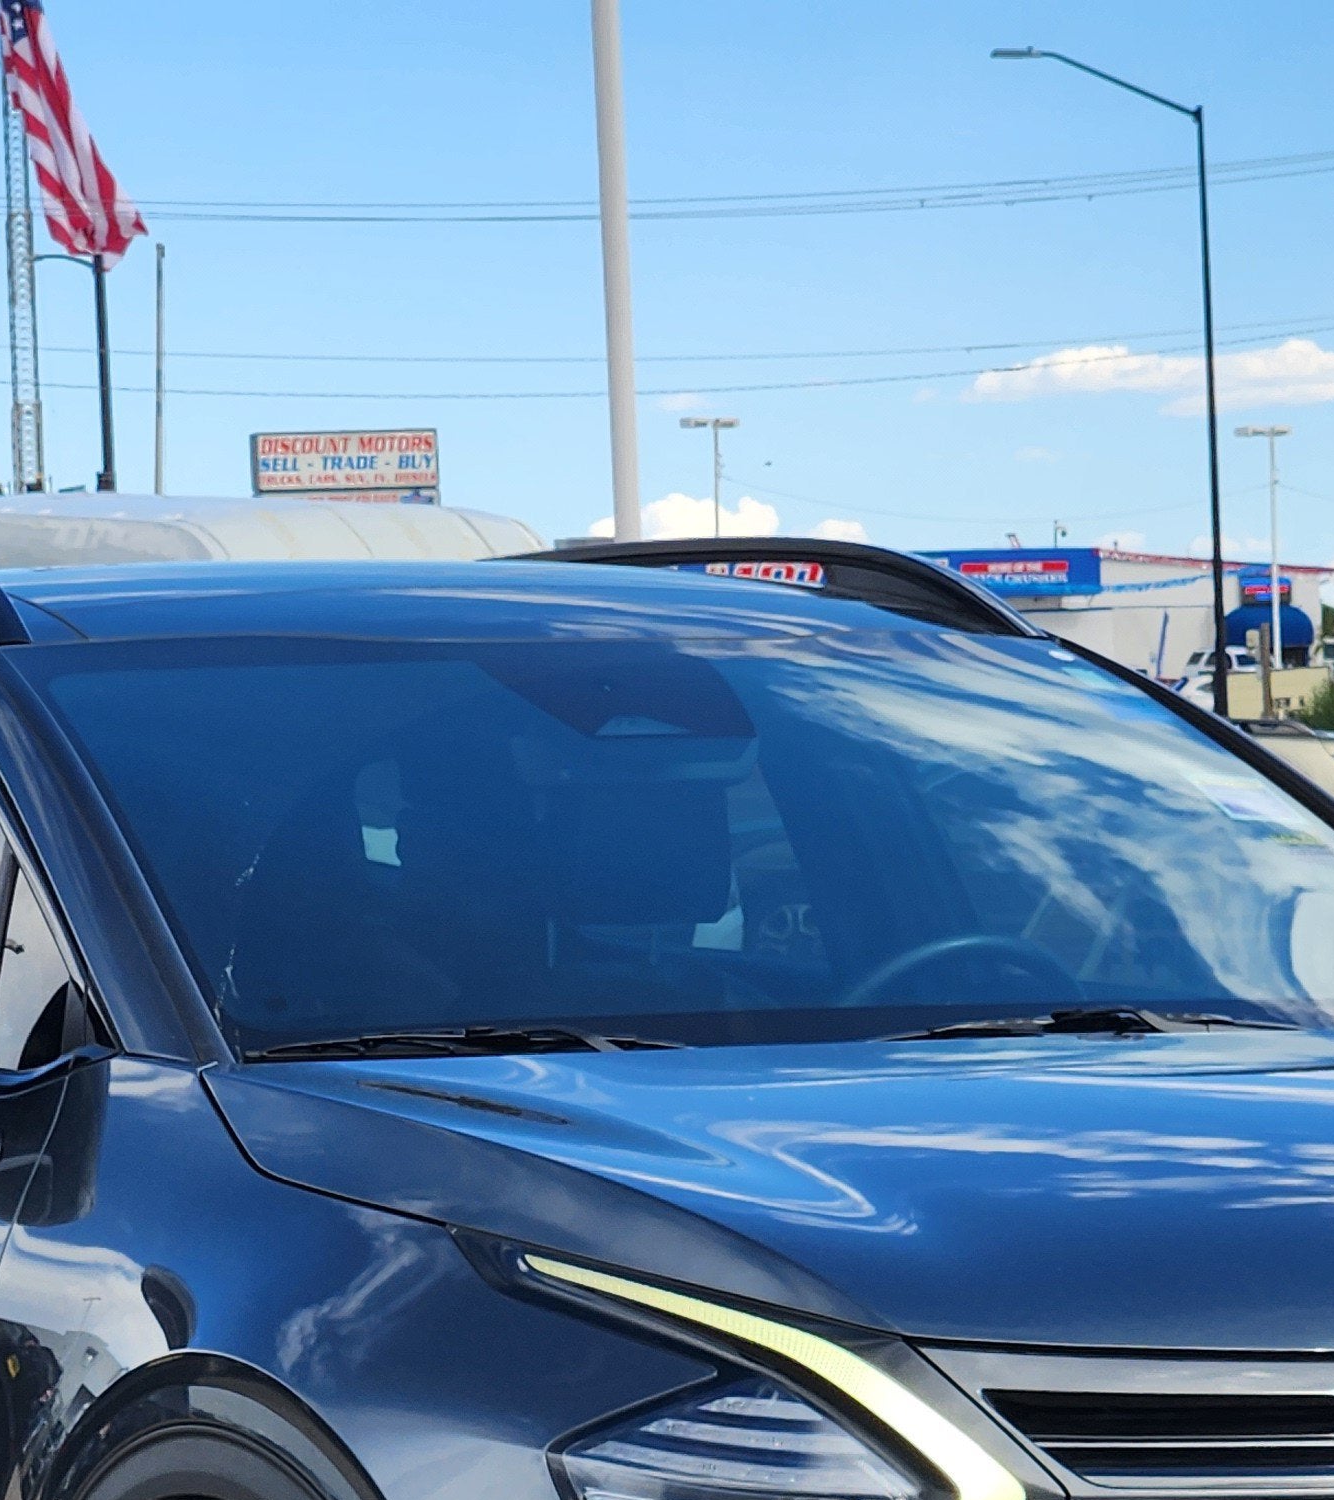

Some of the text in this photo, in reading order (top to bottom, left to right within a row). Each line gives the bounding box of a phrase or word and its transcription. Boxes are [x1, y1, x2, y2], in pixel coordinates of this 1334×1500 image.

[261, 434, 433, 455] DISCOUNT MOTORS
[260, 457, 299, 472] SELL
[321, 455, 378, 471] TRADE
[398, 454, 434, 469] BUY
